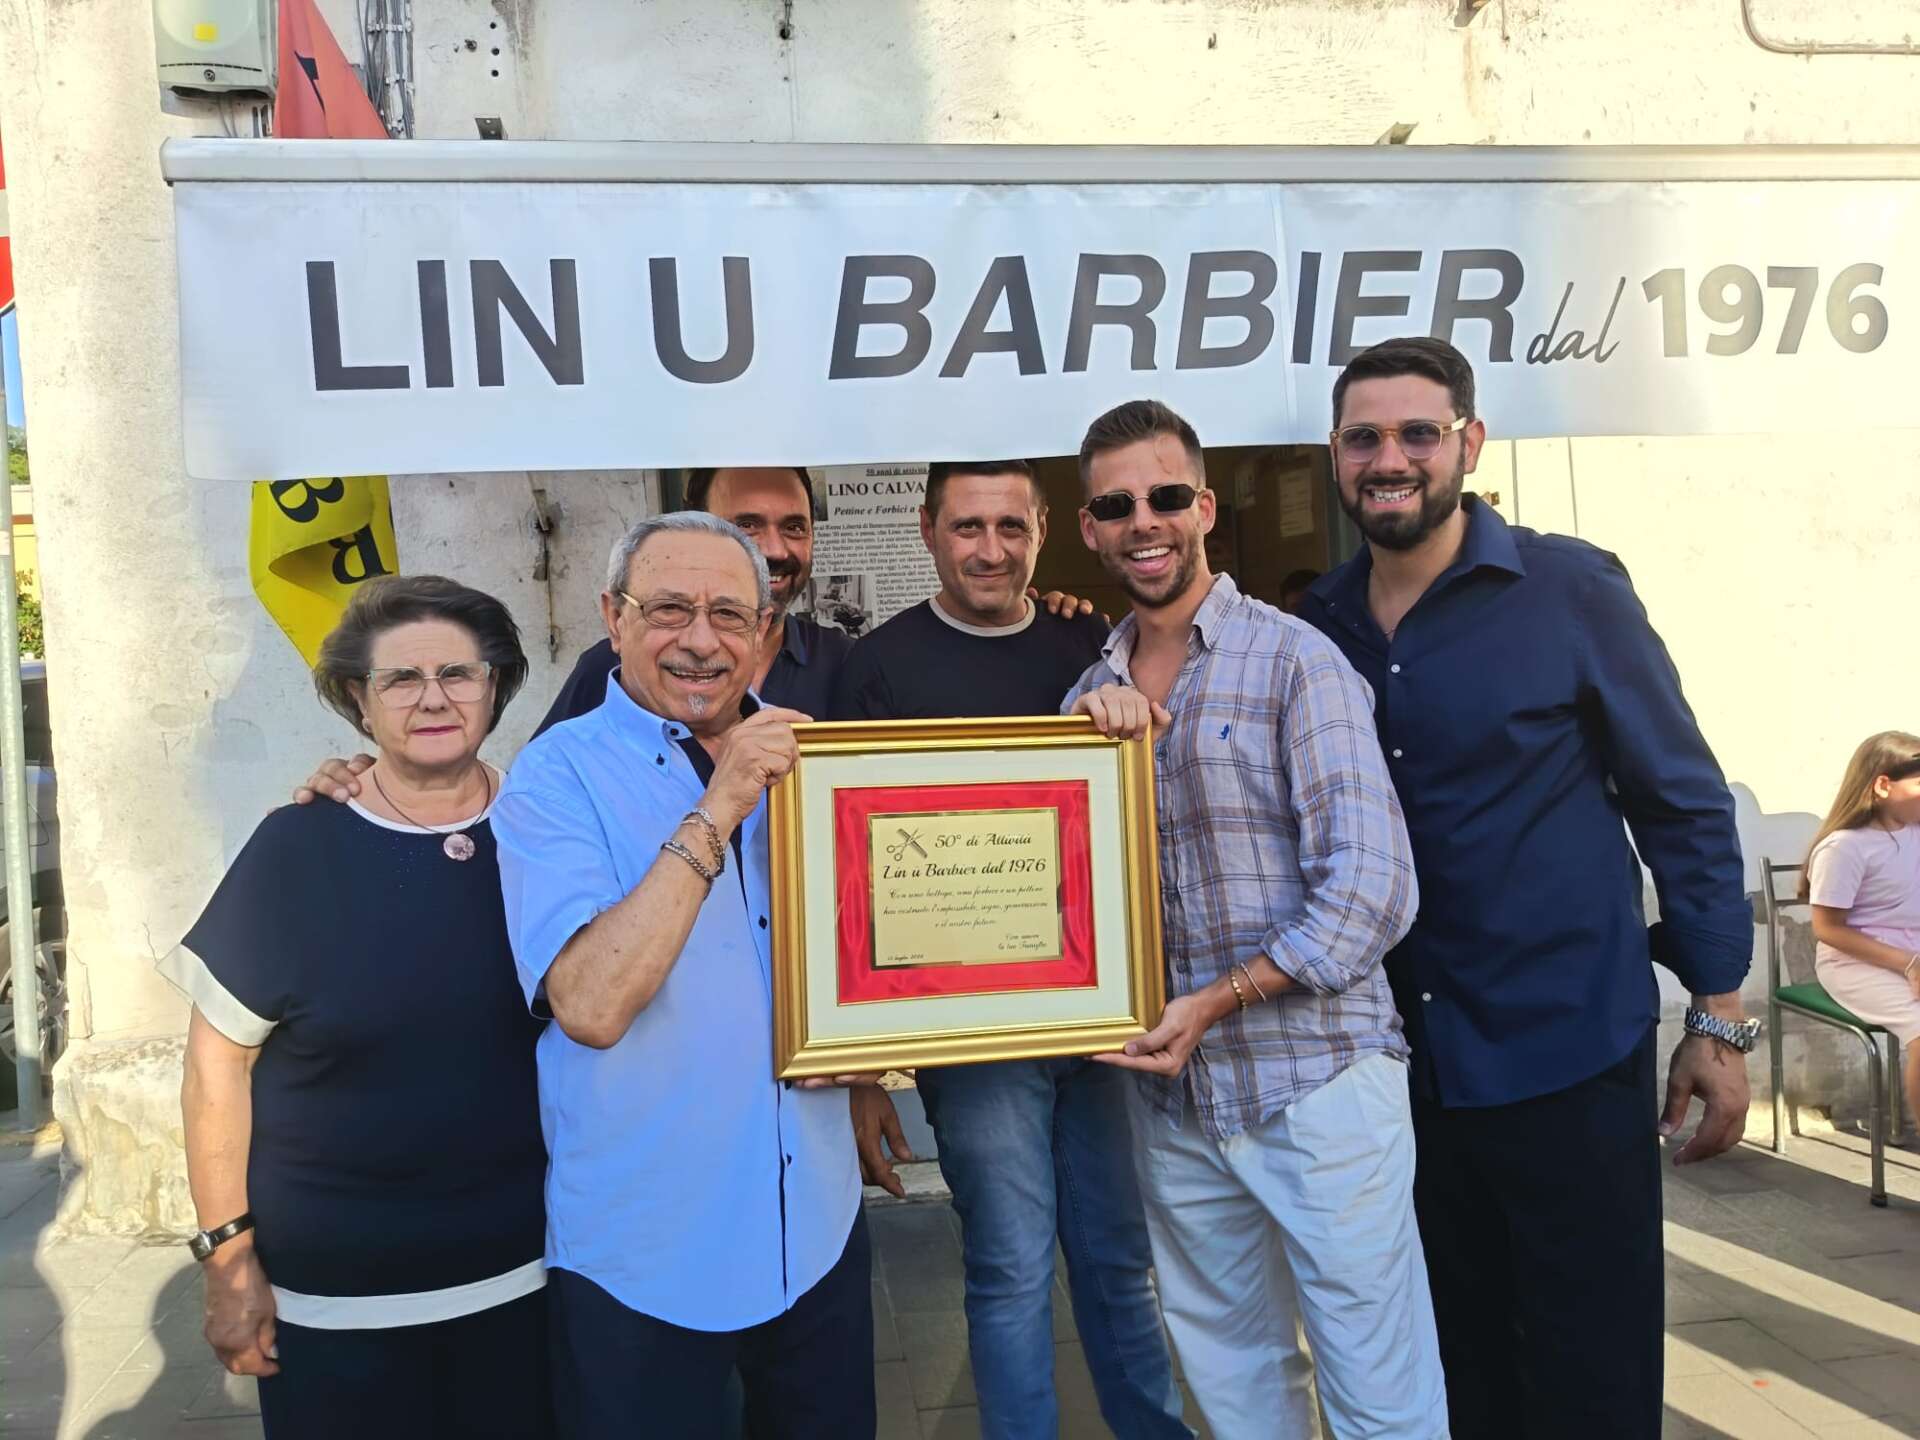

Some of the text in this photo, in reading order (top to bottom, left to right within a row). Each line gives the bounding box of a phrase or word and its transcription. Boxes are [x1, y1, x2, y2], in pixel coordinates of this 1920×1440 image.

[306, 249, 1889, 391] LIN U BARBIER dal 1976
[829, 481, 926, 496] LINO CALVA
[834, 506, 864, 516] Pettine
[875, 505, 907, 515] Forbici
[935, 833, 962, 849] 50°
[966, 834, 979, 846] di
[883, 865, 907, 879] Lin
[925, 863, 976, 878] Barbier
[981, 860, 1007, 874] dal
[1008, 858, 1047, 873] 1976
